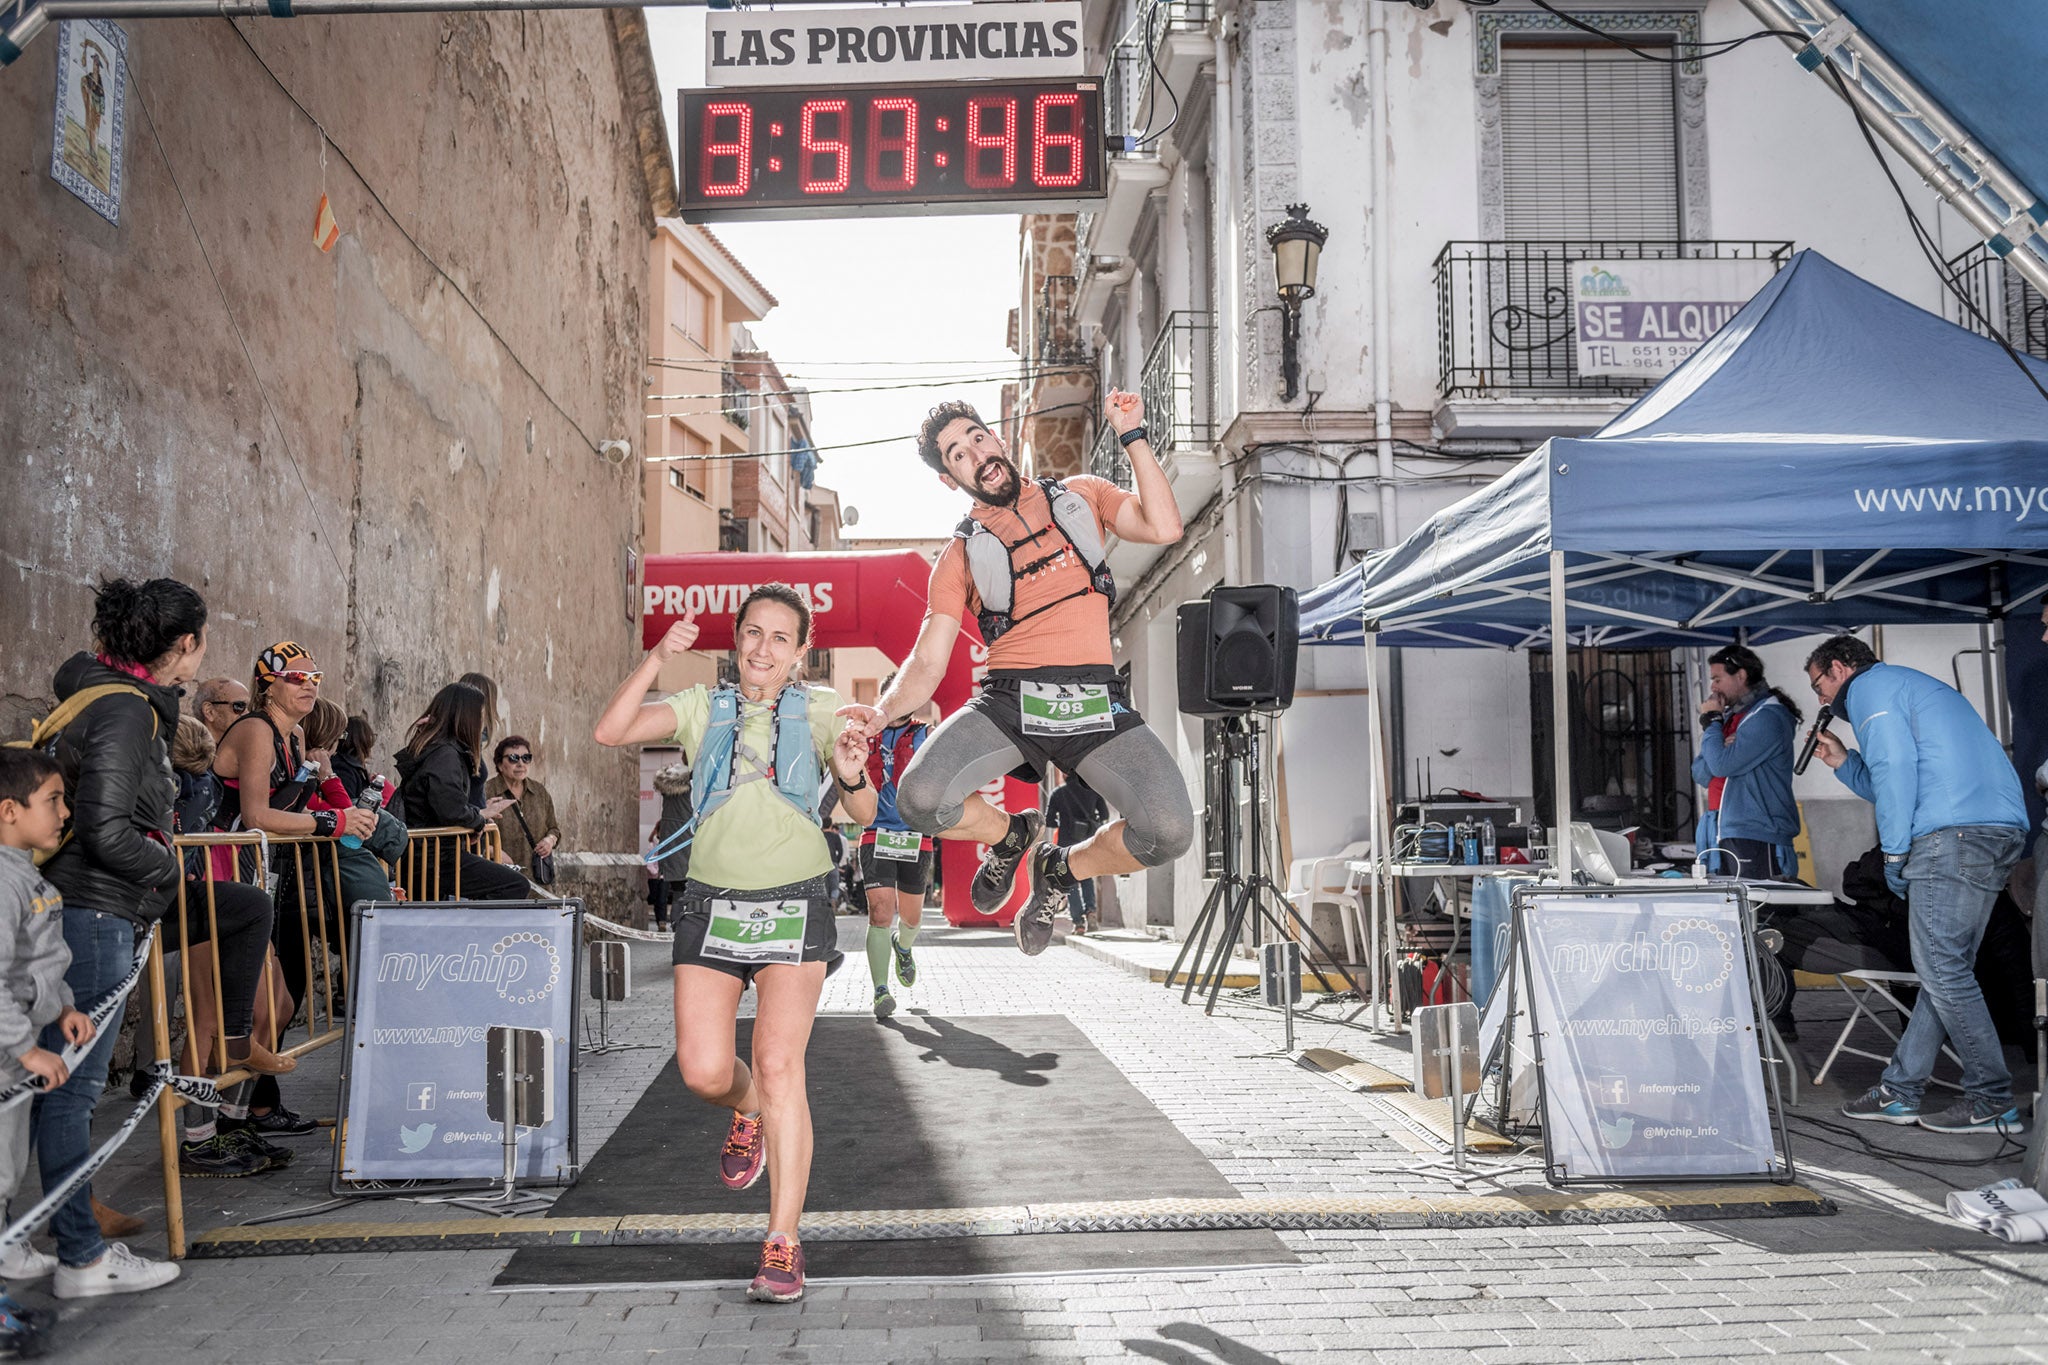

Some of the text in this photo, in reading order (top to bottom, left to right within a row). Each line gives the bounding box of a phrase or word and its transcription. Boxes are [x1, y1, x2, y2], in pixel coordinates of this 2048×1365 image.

[712, 19, 1079, 67] LAS PROVINCIAS
[703, 92, 1083, 196] 3:57:46
[1584, 305, 1624, 339] SE
[1632, 346, 1661, 356] 651
[1633, 359, 1663, 368] 964
[1854, 485, 2048, 522] www.myc
[643, 582, 833, 616] PROVINAS
[1046, 701, 1084, 715] 798
[888, 836, 908, 846] 542
[737, 919, 777, 937] 799
[377, 943, 527, 992] mychip
[1551, 931, 1699, 981] mychip
[1556, 1013, 1737, 1040] www.mychip.es
[1639, 1083, 1701, 1097] /infomychip
[1643, 1126, 1719, 1139] @Mychip_Info
